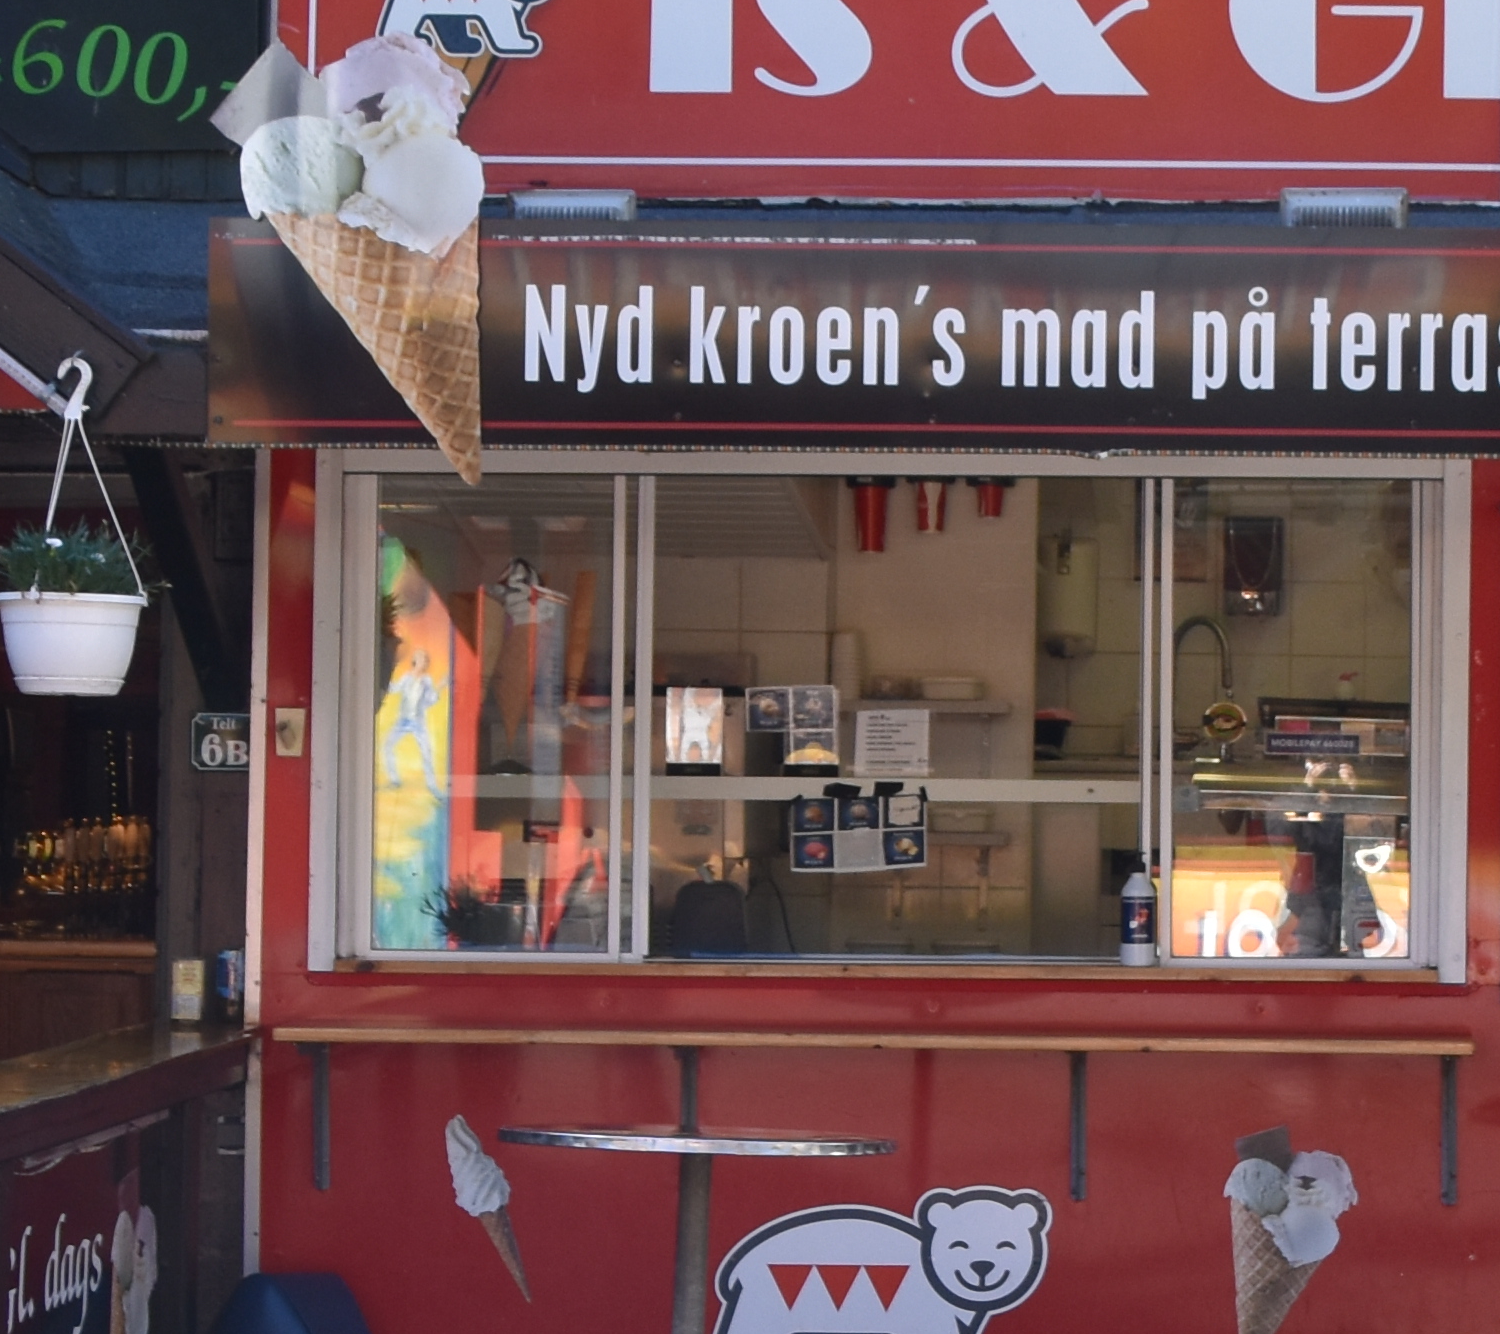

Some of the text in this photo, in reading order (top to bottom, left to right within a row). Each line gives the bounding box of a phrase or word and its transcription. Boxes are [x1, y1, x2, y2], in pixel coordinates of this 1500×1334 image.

[524, 284, 653, 393] Nyd
[1000, 287, 1156, 391] mad
[1191, 286, 1276, 401] på
[210, 717, 236, 730] Telt
